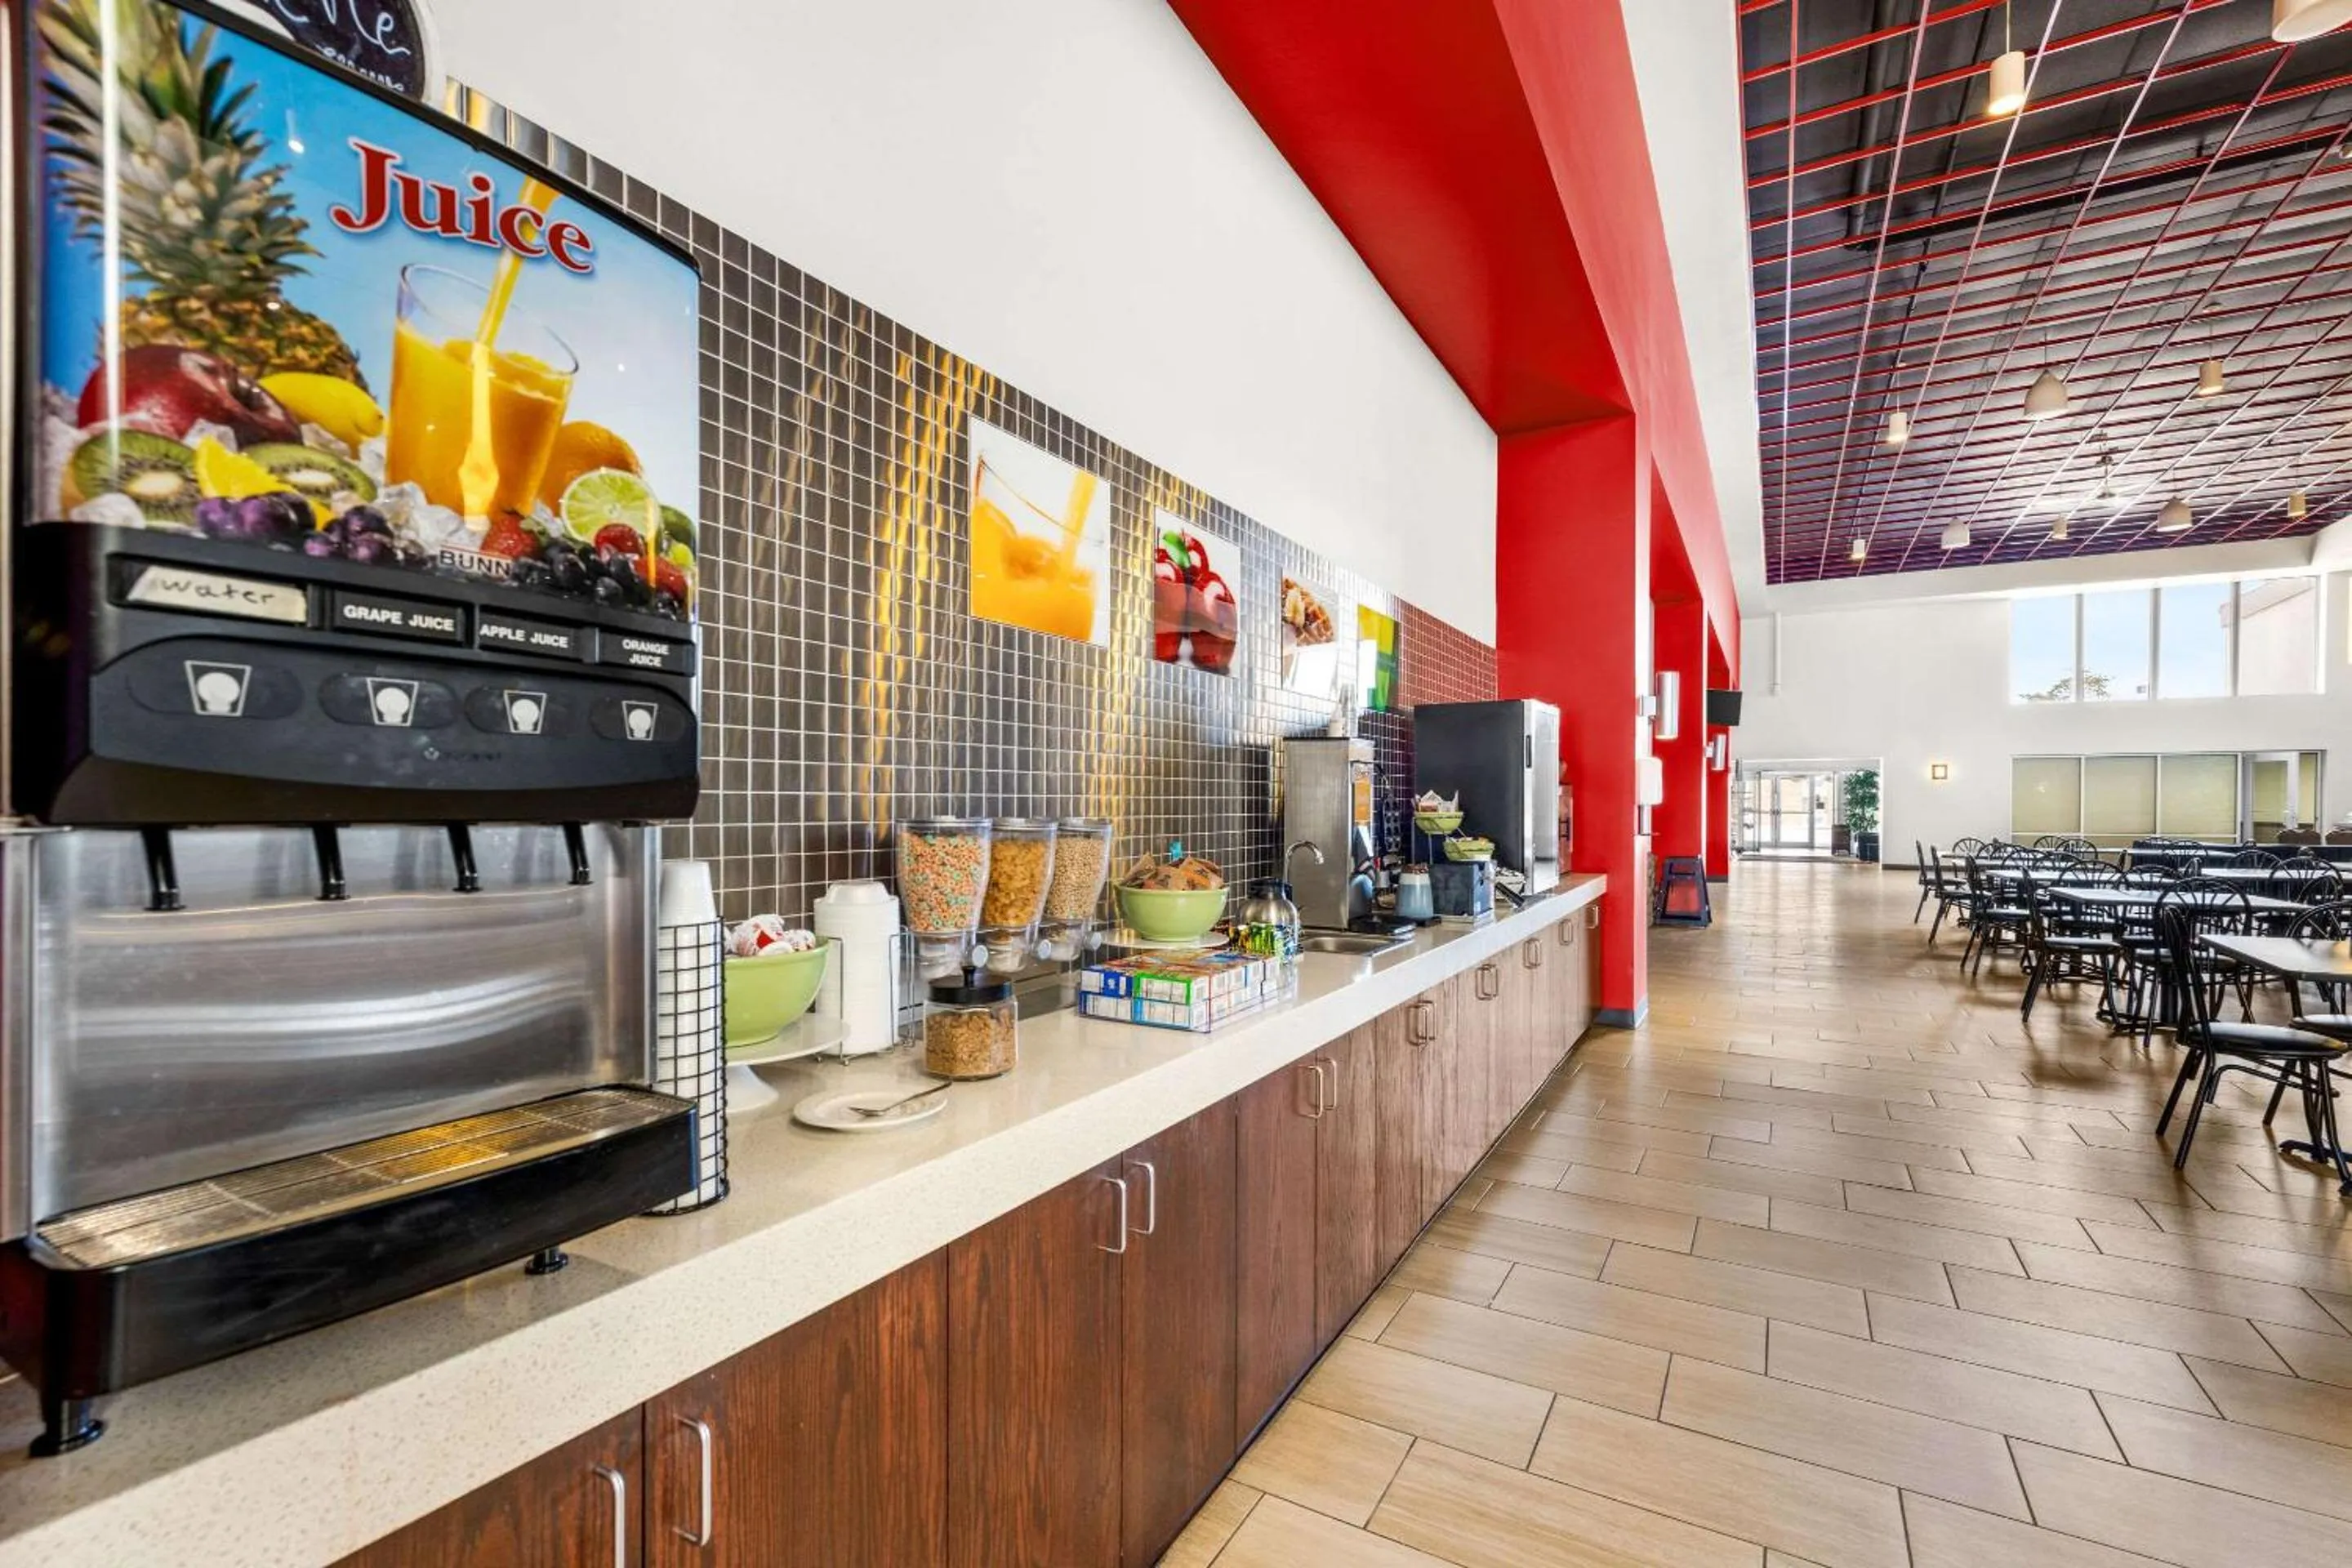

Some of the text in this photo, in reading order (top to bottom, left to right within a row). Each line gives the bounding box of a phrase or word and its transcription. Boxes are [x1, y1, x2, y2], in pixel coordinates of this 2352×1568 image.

[330, 136, 595, 273] Juice
[439, 550, 511, 576] BUNN
[343, 604, 455, 631] GRAPE JUICE
[479, 624, 569, 648] APPLE JUICE
[622, 639, 670, 654] ORANGE
[629, 653, 662, 667] JUICE
